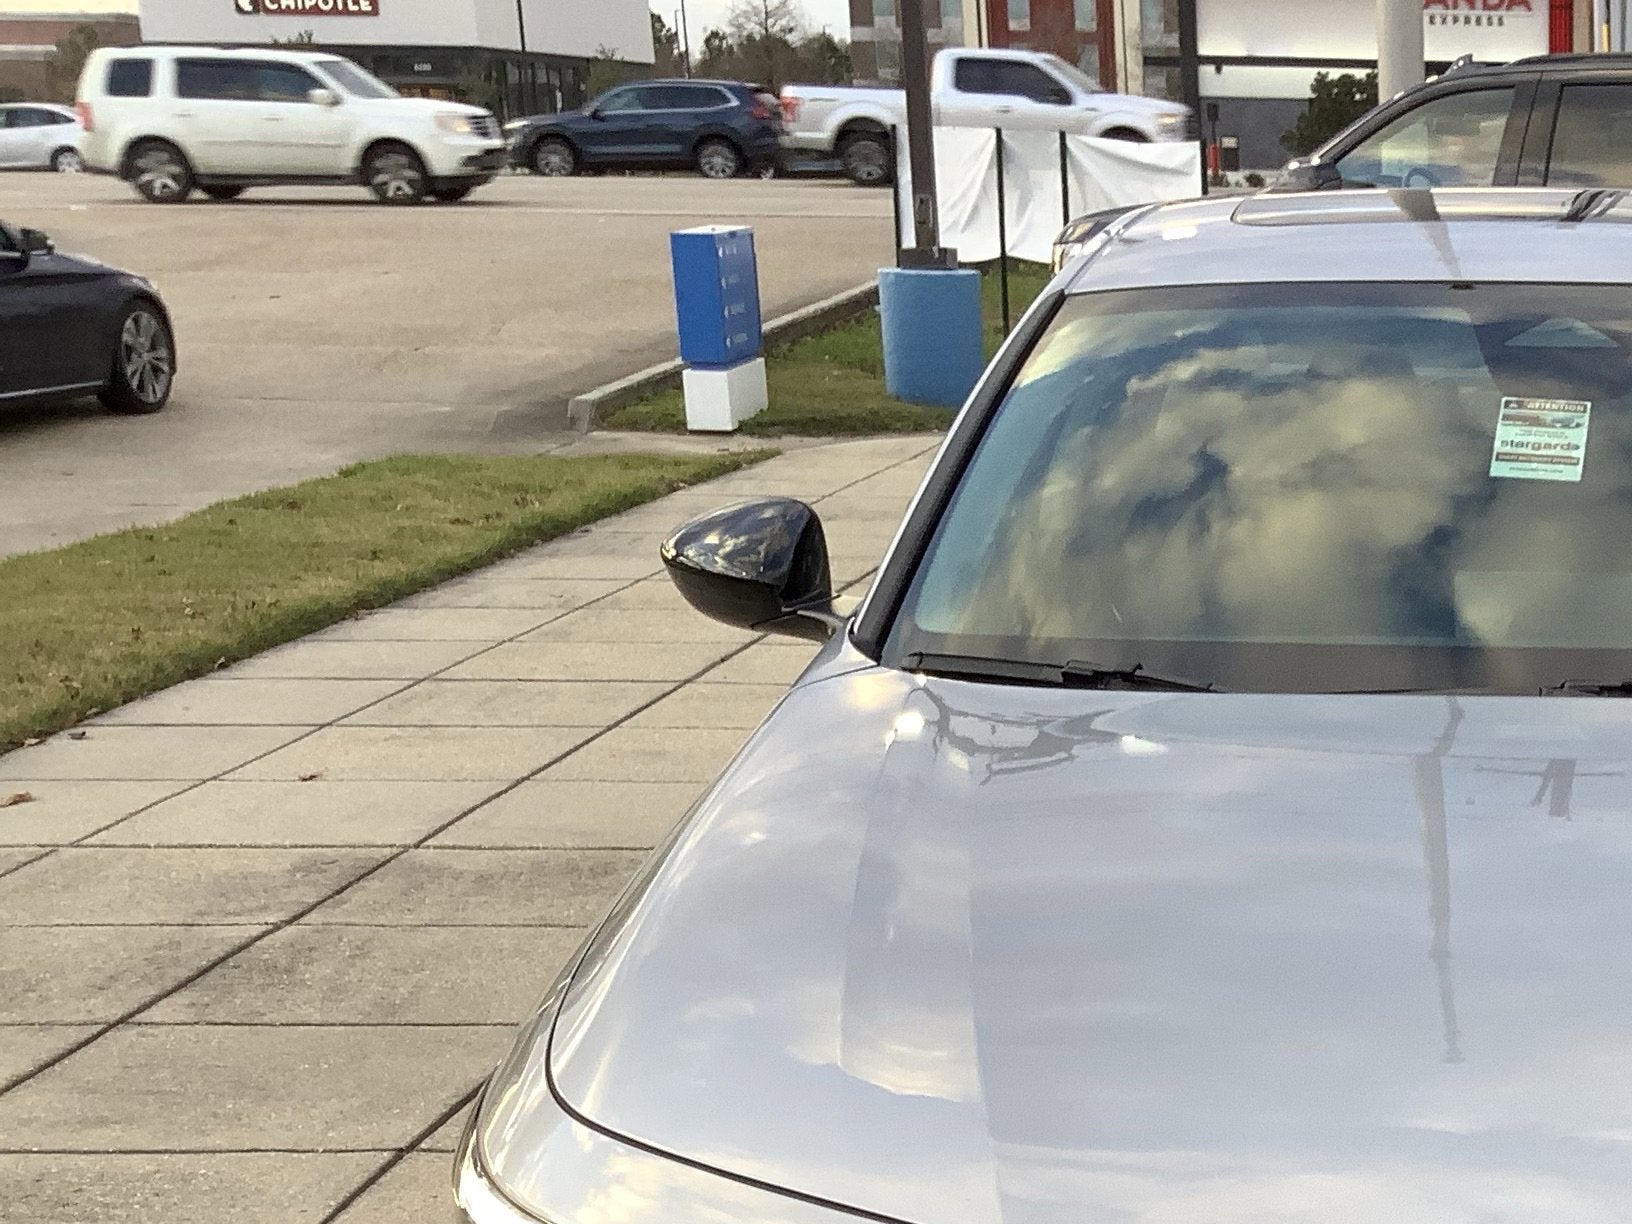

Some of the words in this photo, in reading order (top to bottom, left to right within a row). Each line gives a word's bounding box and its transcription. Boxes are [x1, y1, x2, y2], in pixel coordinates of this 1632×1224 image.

[263, 0, 373, 12] CHIPOTLE
[1423, 0, 1533, 12] ANDA
[1428, 15, 1505, 27] EXPRESS
[1527, 402, 1585, 412] ATTENTION
